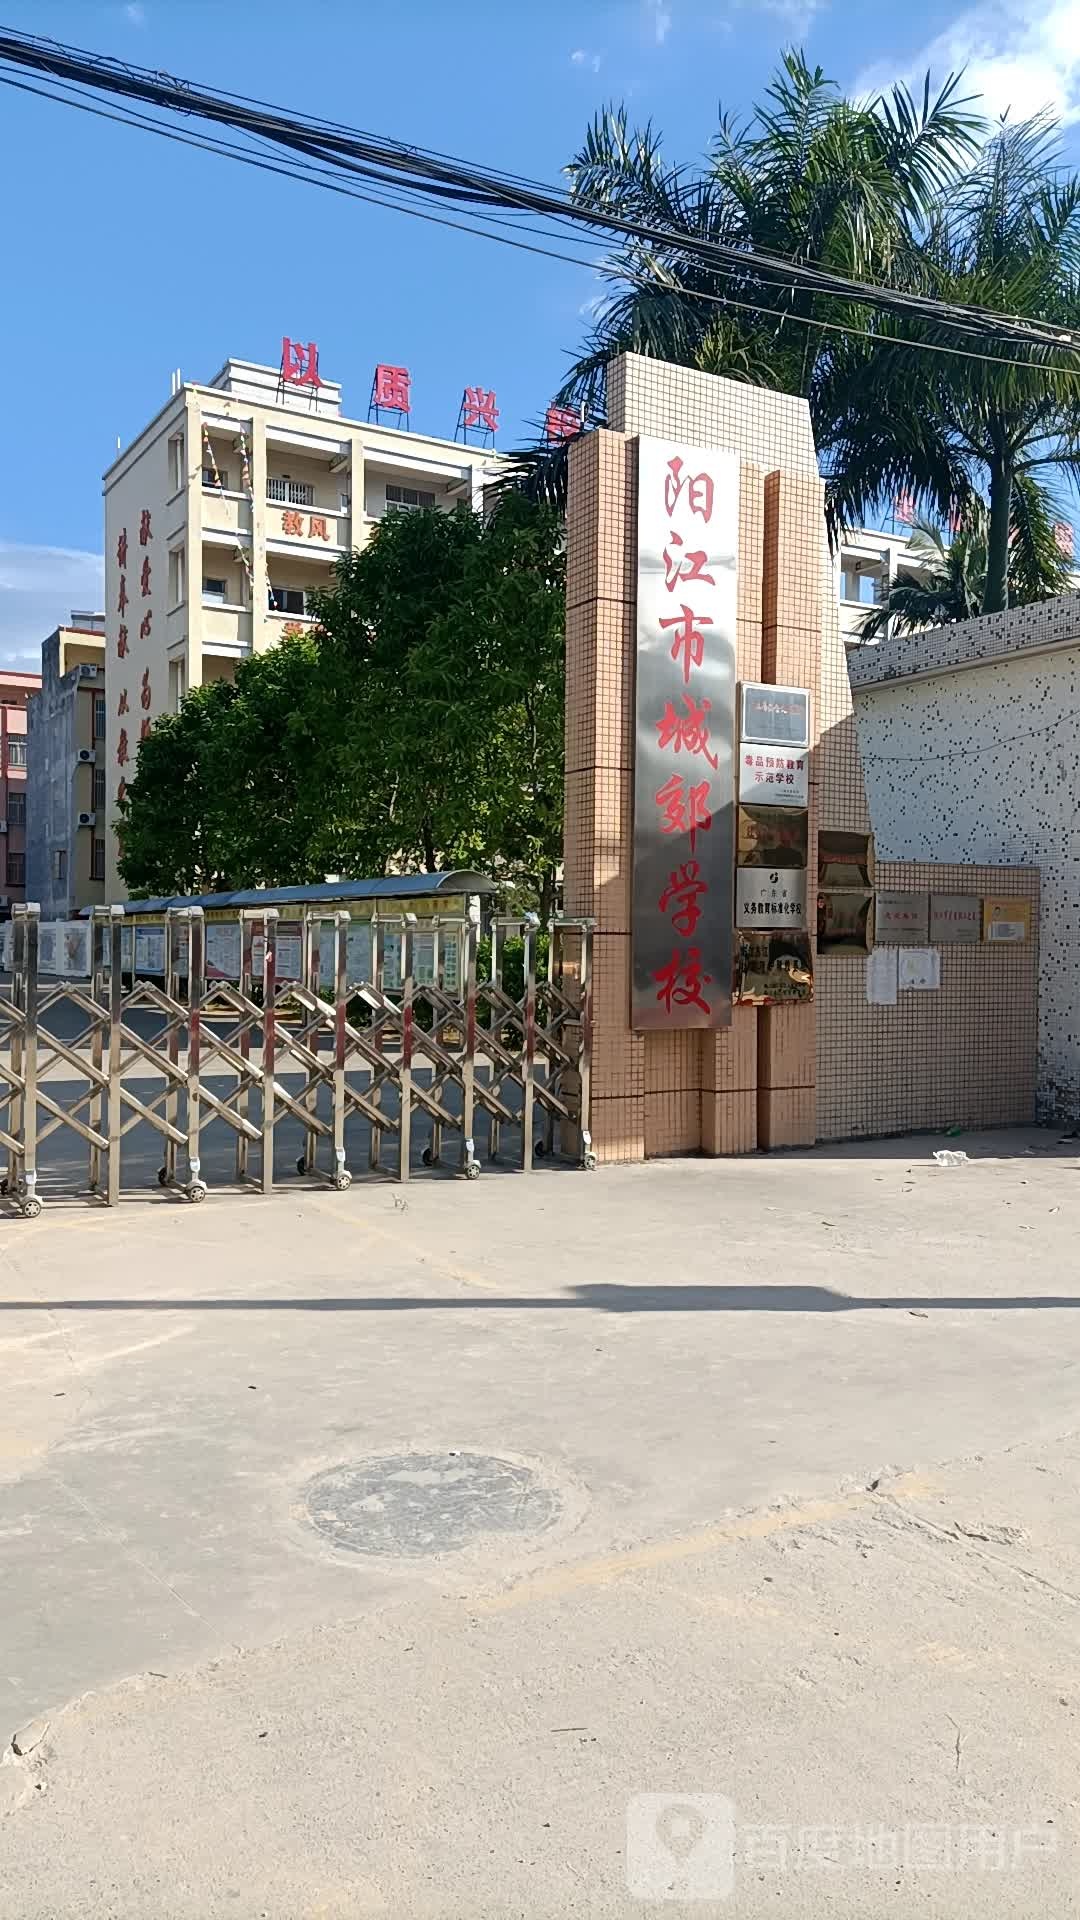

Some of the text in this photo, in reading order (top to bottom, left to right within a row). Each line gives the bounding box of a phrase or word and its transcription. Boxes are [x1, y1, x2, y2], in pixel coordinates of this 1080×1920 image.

[282, 510, 331, 541] 教风
[654, 457, 719, 1014] 阳江市城郊学校
[744, 754, 805, 771] 毒品预防教育
[754, 771, 795, 785] 示范学校
[761, 889, 788, 899] 广东省
[743, 902, 802, 915] 义务教育标准化学校
